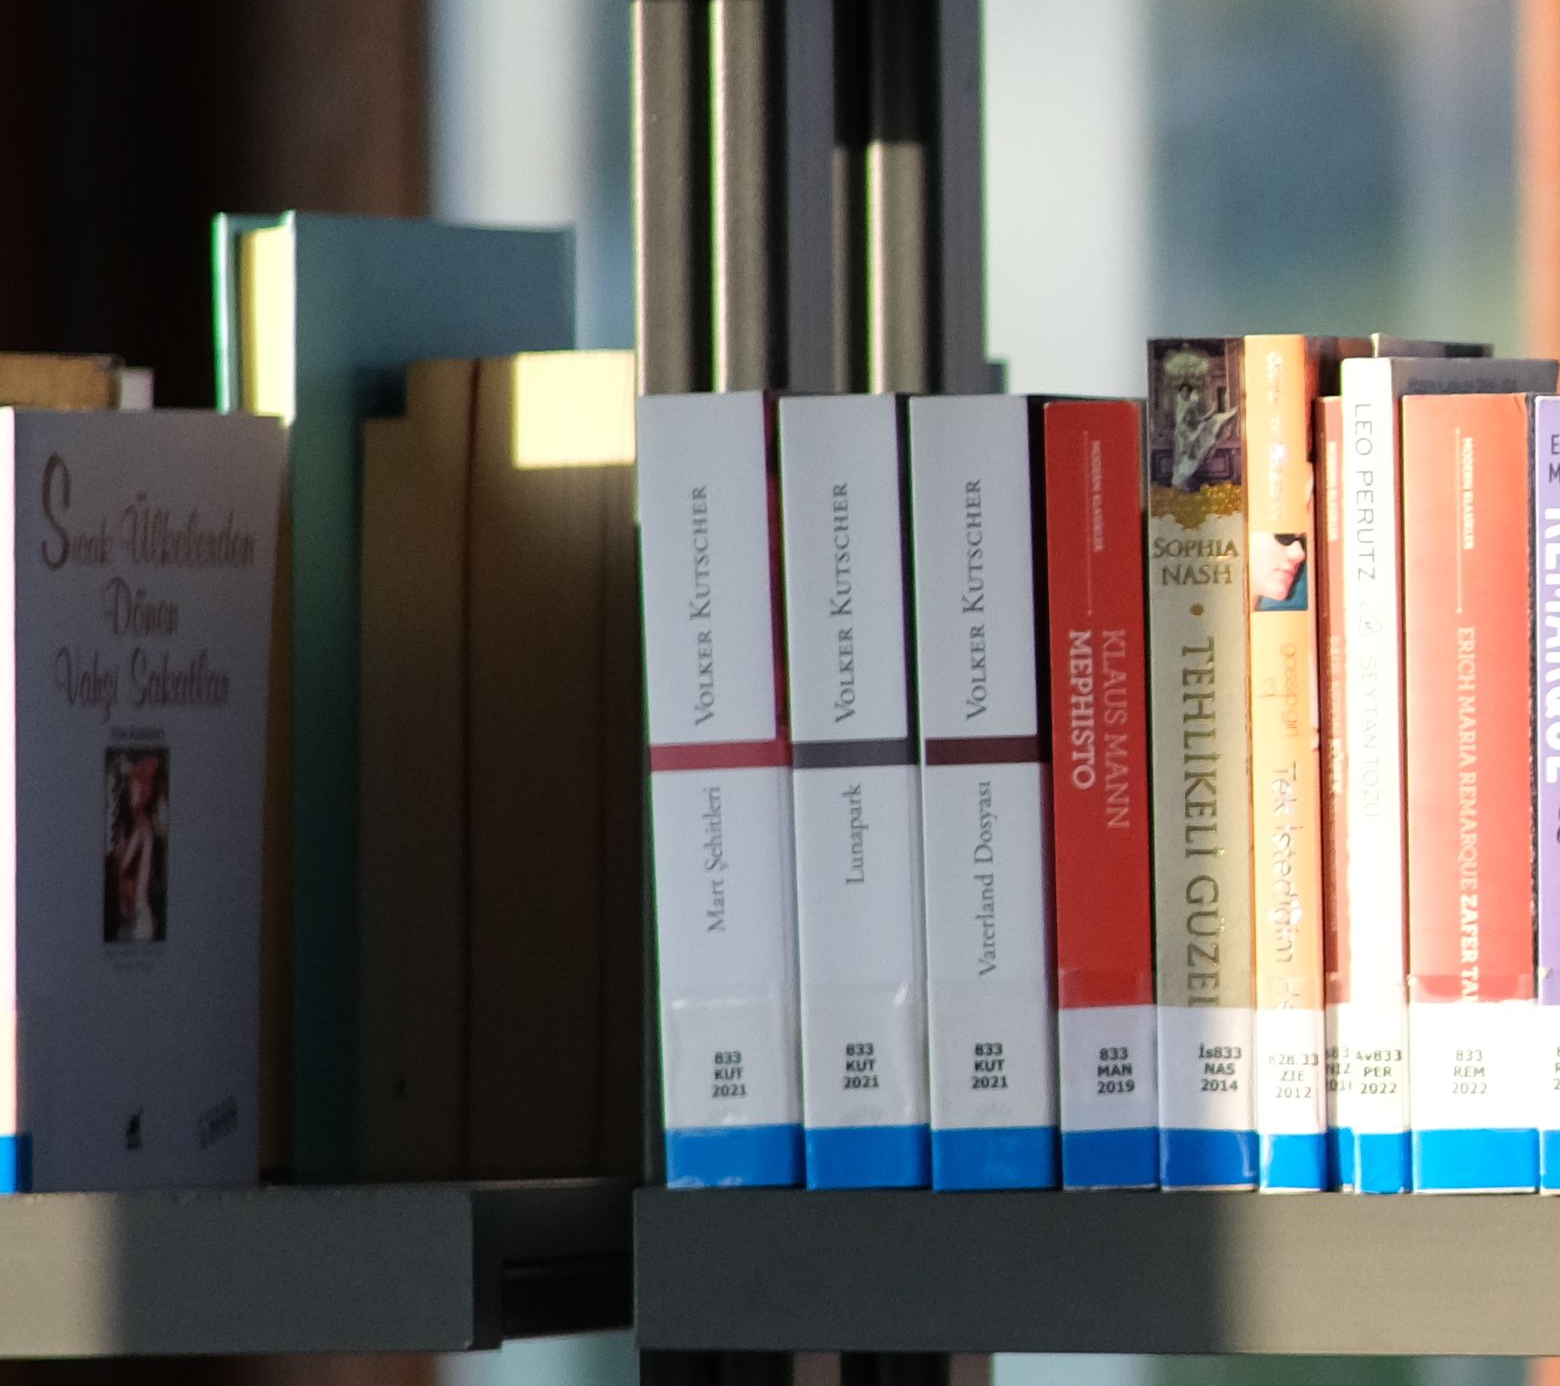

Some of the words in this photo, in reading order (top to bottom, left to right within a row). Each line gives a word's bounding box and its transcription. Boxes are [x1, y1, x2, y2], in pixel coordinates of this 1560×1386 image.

[1354, 403, 1376, 456] LEO
[1355, 469, 1377, 583] PERUTZ
[1069, 629, 1095, 790] MEPHISTO
[1100, 629, 1127, 726] KLAUS
[1103, 733, 1130, 830] MANN
[843, 1075, 880, 1088] 2021
[846, 1043, 875, 1056] 833
[846, 1059, 876, 1072] KUT
